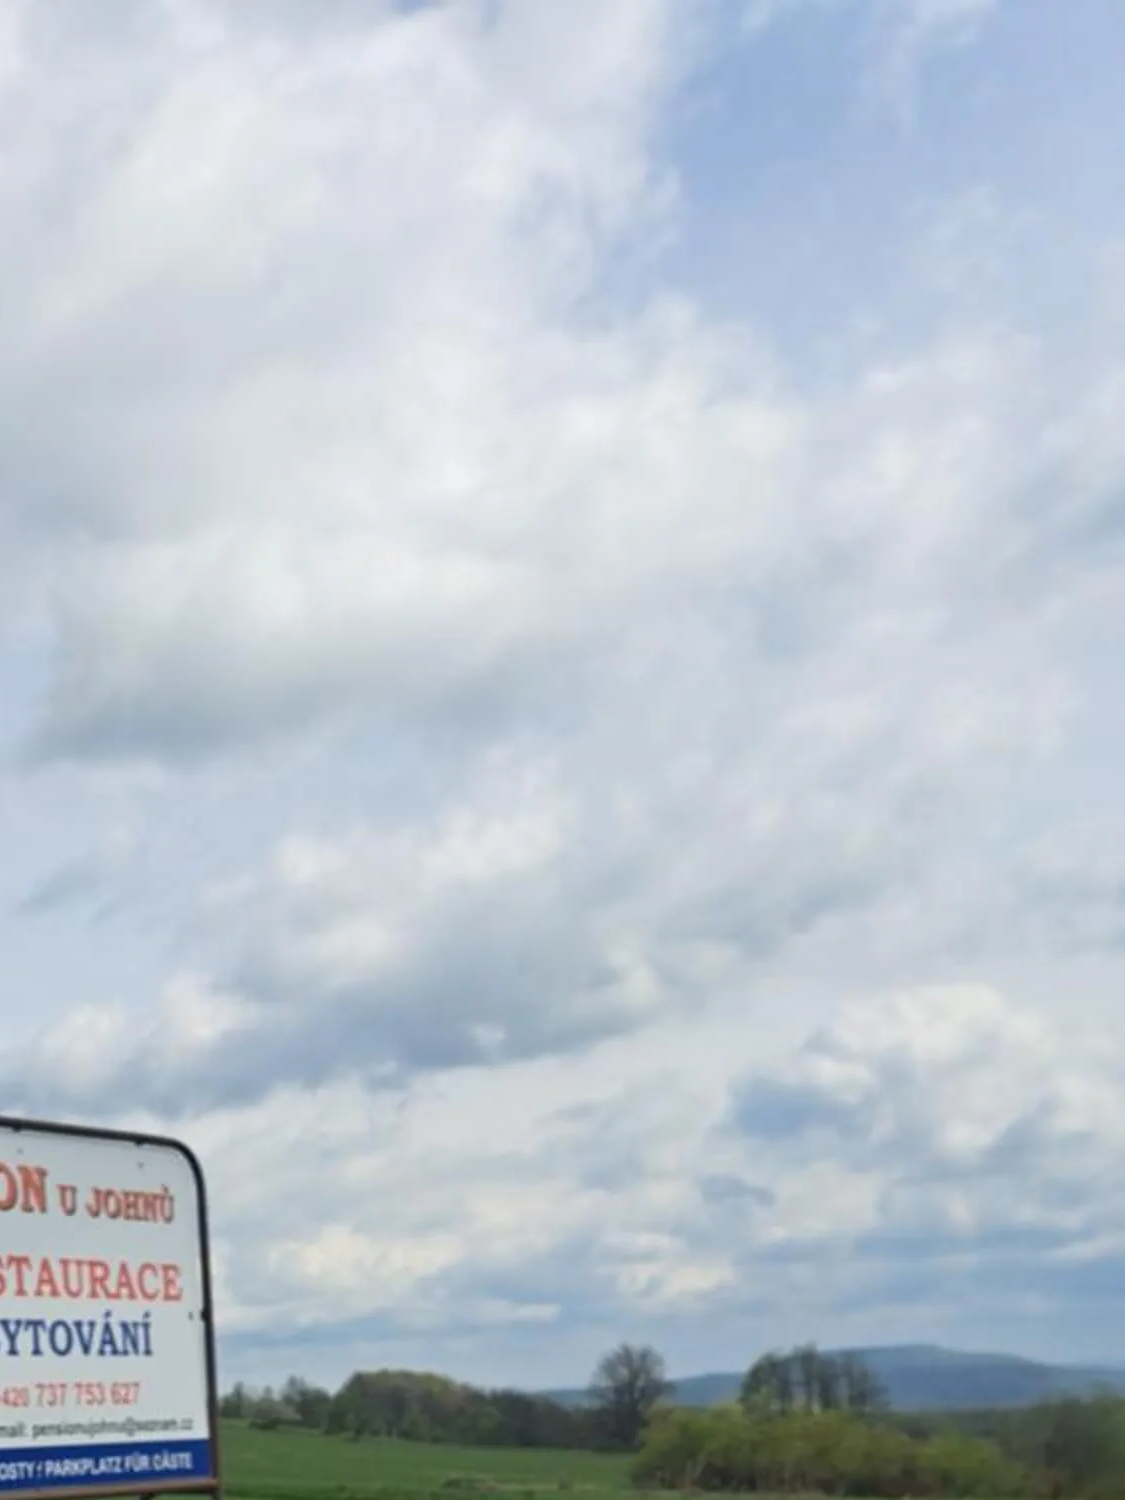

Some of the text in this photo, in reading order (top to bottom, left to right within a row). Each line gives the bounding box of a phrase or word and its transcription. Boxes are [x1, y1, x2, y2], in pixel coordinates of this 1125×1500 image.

[57, 1184, 78, 1216] U
[86, 1184, 175, 1224] JOHNŮ
[35, 1383, 67, 1406] 737
[74, 1382, 106, 1405] 753
[110, 1381, 140, 1404] 627
[44, 1456, 124, 1477] PARKPLATZ
[125, 1452, 150, 1472] FÜR
